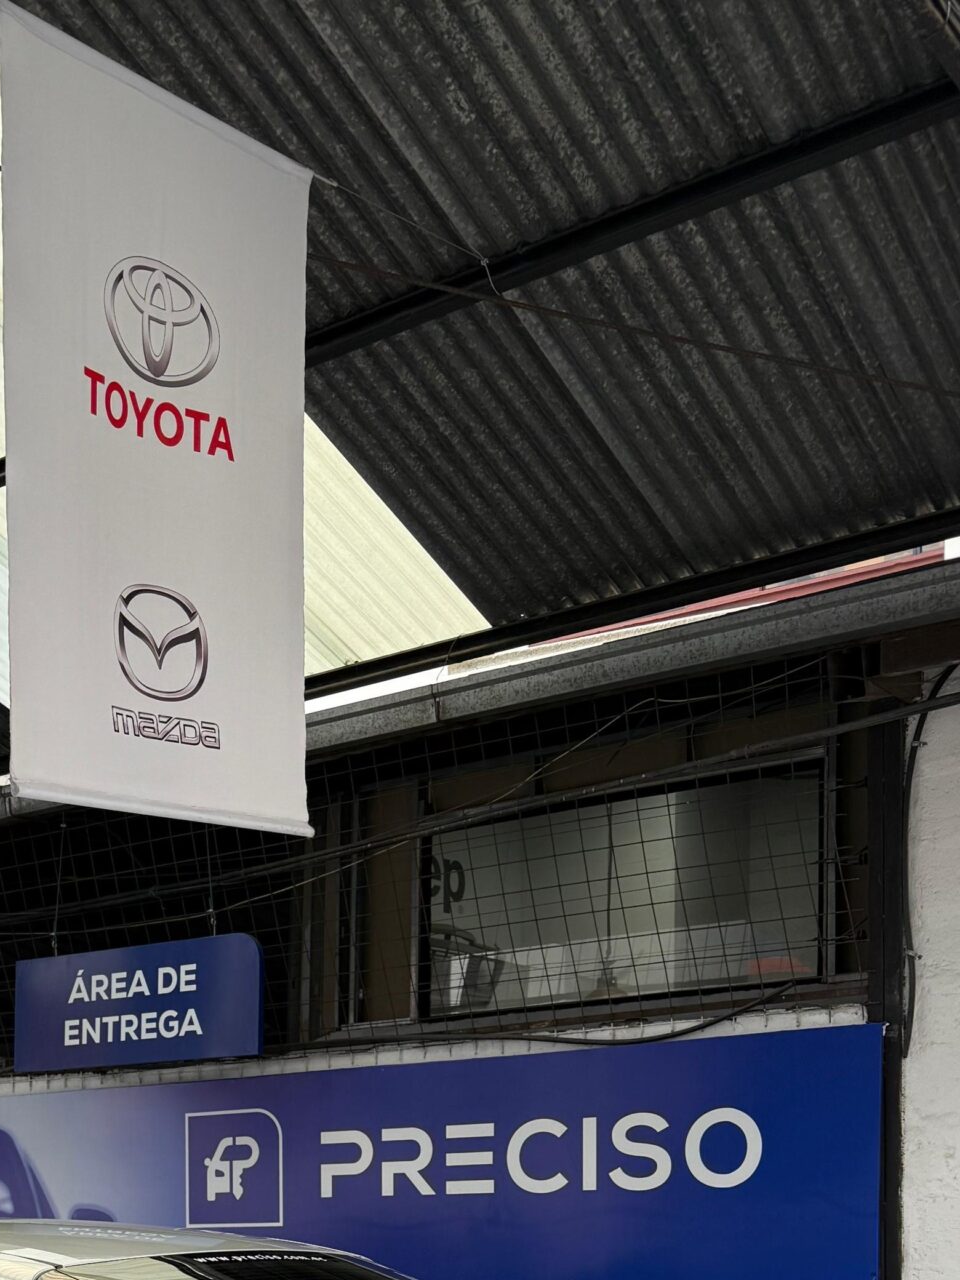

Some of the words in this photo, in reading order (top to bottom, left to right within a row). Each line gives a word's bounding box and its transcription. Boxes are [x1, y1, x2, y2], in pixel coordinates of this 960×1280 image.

[83, 365, 236, 463] TOYOTA
[68, 968, 150, 1004] ÁREA
[157, 963, 197, 995] DE
[64, 1008, 203, 1047] ENTREGA
[320, 1106, 763, 1199] PRECISO
